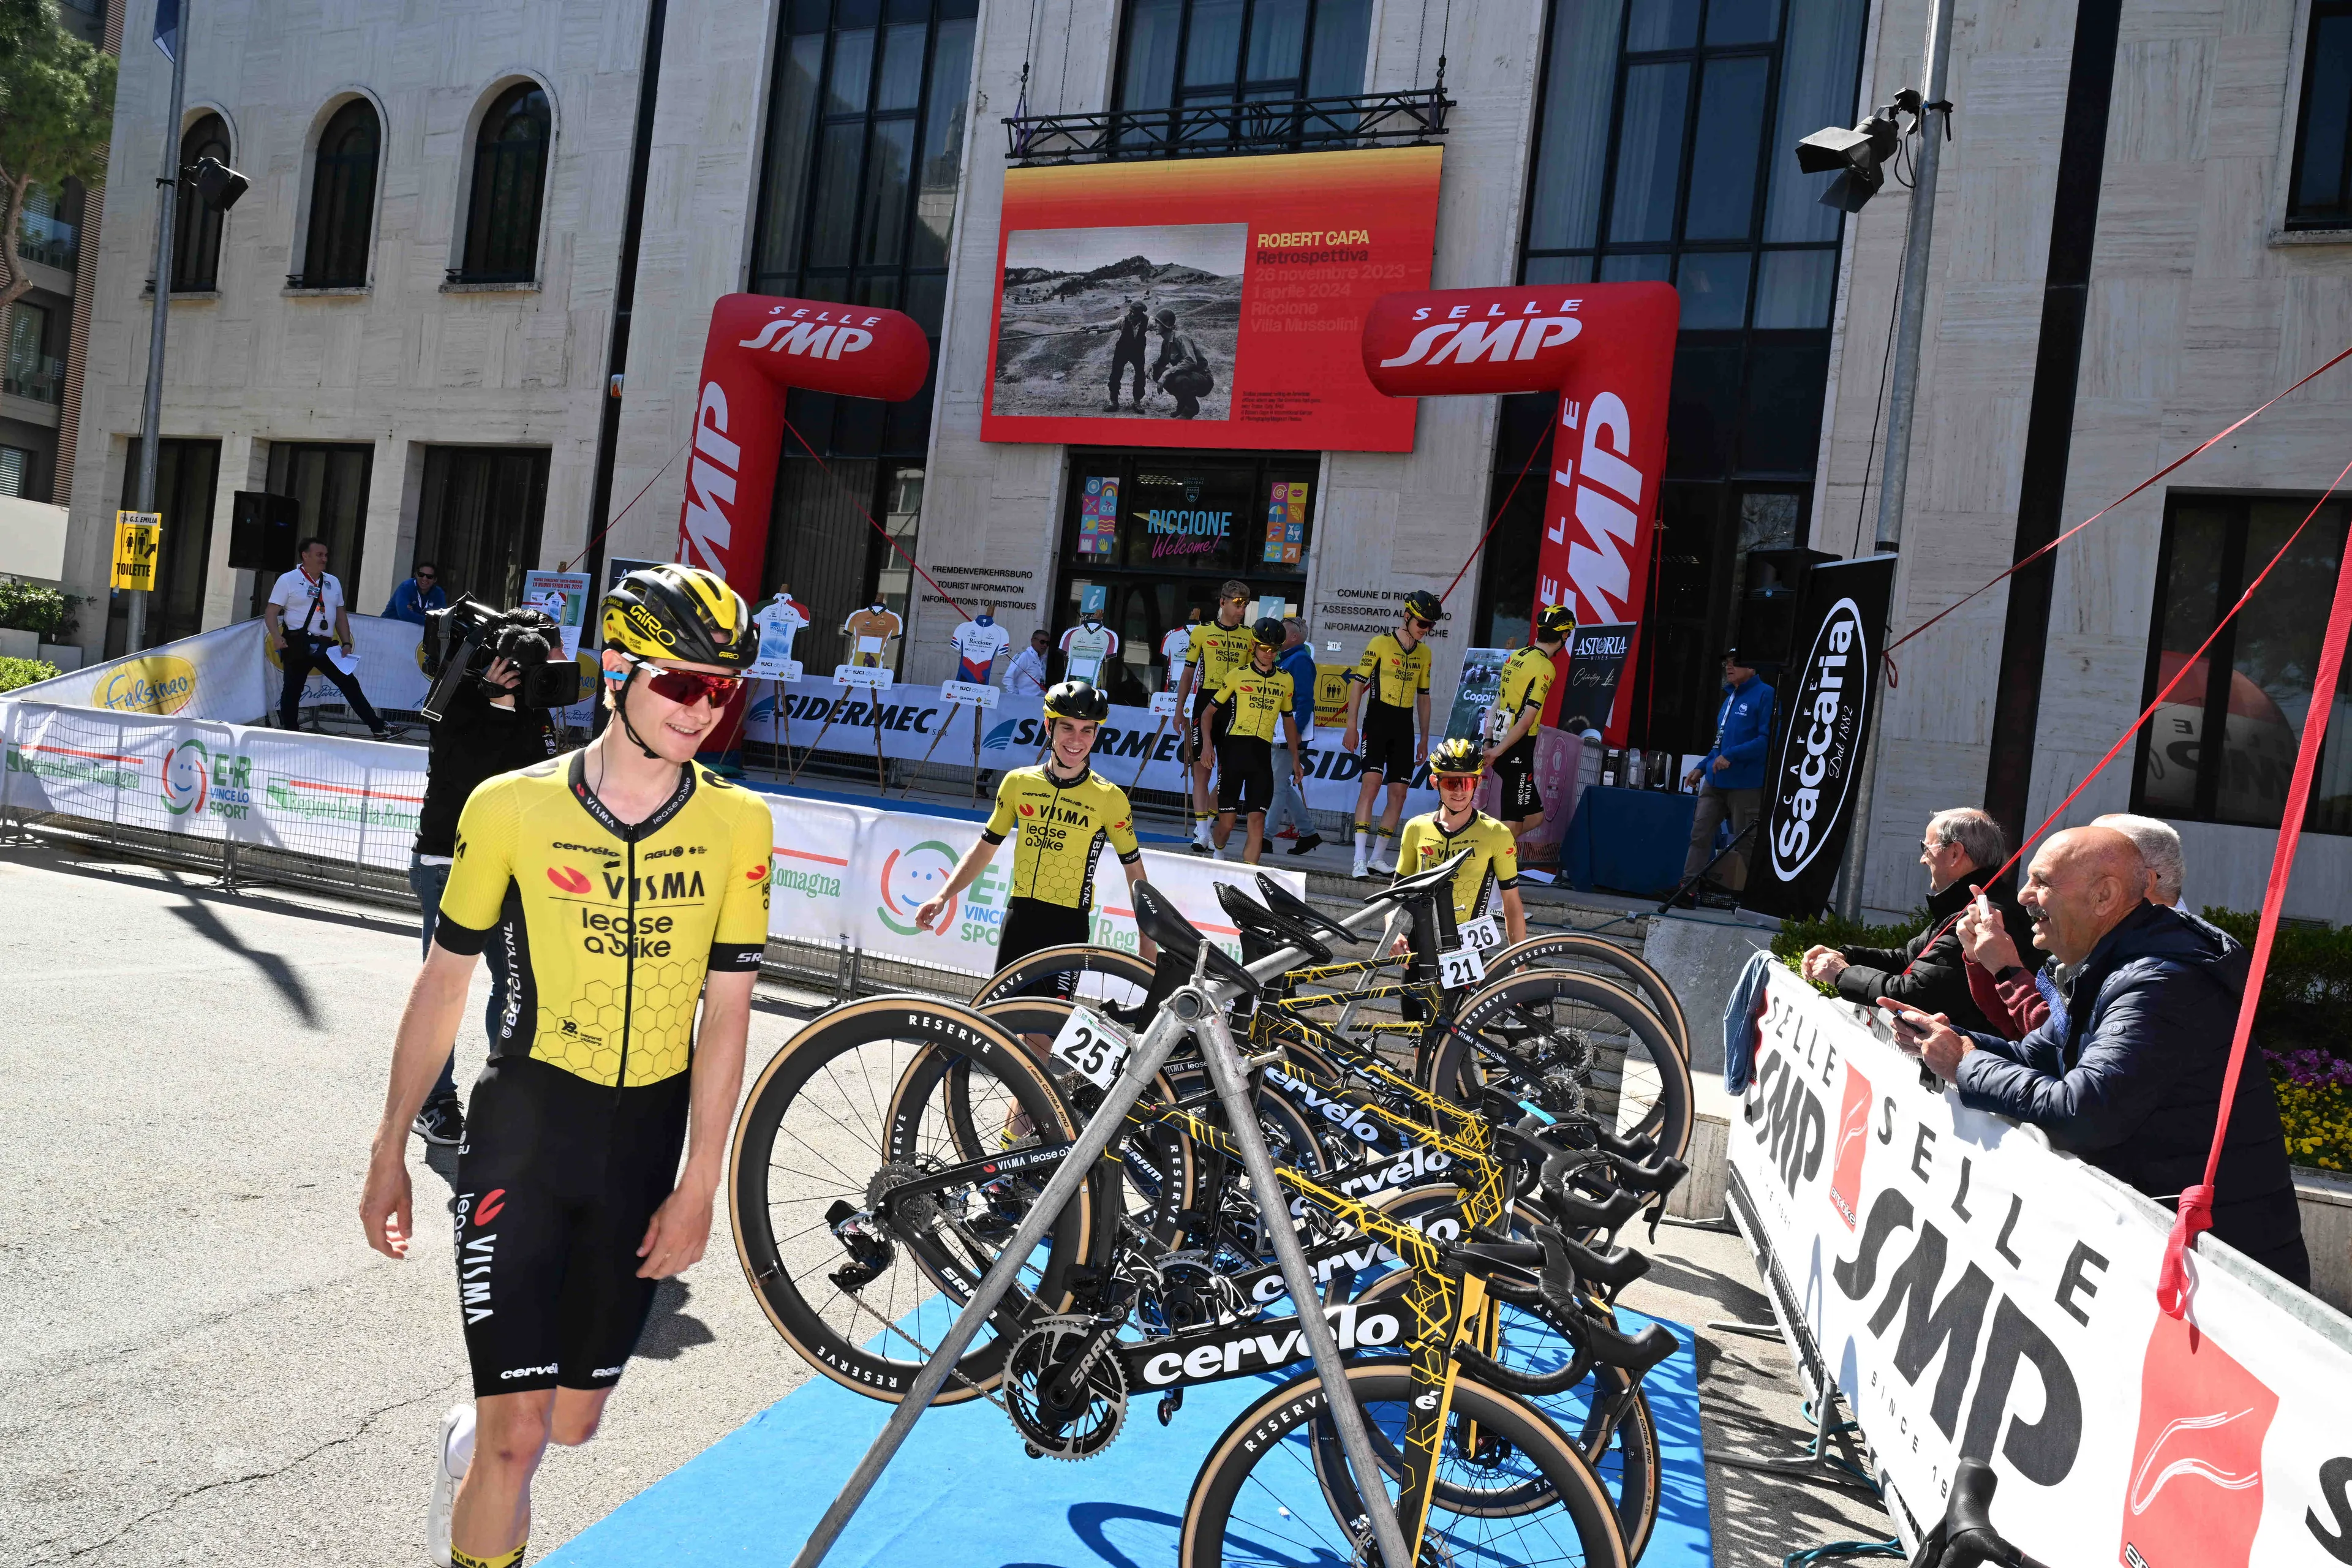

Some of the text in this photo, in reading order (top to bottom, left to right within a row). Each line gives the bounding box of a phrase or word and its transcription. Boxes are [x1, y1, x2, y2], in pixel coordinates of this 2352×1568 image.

[1257, 230, 1370, 247] ROBERT CAPA
[1256, 247, 1368, 265] Retrospettiva
[1255, 264, 1405, 281] 26 novembre 2023
[1262, 284, 1304, 301] aprile
[1309, 282, 1351, 297] 2024
[769, 306, 881, 327] SELLE
[1251, 301, 1318, 316] Riccione
[1412, 299, 1583, 320] SELLE
[1250, 317, 1358, 333] Villa Mussolini
[739, 320, 873, 361] SMP
[1379, 317, 1583, 368] SMP
[1148, 510, 1232, 537] RICCIONE
[1152, 529, 1223, 559] Welcome!
[116, 562, 151, 577] TOILETTE
[932, 565, 1033, 579] FREMDENVERKEHRSBURO
[937, 581, 1023, 594] TOURIST INFORMATION
[1337, 589, 1391, 600] COMUNE DI
[922, 595, 1036, 610] INFORMATIONS TOURISTIQUES
[1322, 605, 1390, 617] ASSESSORATO
[629, 605, 676, 646] GIRO
[1324, 622, 1390, 633] NFORMAZIONI
[969, 638, 992, 646] Riccione
[1221, 641, 1248, 650] VISMA
[1575, 636, 1627, 655] ASTORIA
[718, 650, 739, 660] GIRO
[1402, 660, 1420, 669] VISMA
[1396, 668, 1414, 677] lease
[1572, 668, 1600, 687] Celebrating
[104, 674, 188, 710] Felsineo
[1250, 695, 1275, 704] lease
[1257, 686, 1284, 697] VISMA
[1463, 689, 1491, 704] Coppi
[772, 694, 938, 734] SIDERMEC
[1778, 620, 1855, 862] Saccaria
[1829, 705, 1854, 778] Dal 1882
[213, 753, 252, 790] E-R
[210, 788, 249, 803] VINCE LO
[209, 801, 249, 820] SPORT
[586, 796, 615, 827] VISMA
[653, 801, 679, 824] lease
[1040, 805, 1088, 827] VISMA
[1027, 823, 1066, 839] lease
[552, 842, 620, 858] cervélo
[644, 848, 673, 861] AGU
[1082, 840, 1101, 908] BETCITY.NL
[602, 871, 705, 902] VISMA
[582, 907, 673, 935] lease
[1468, 925, 1494, 951] 26
[1510, 945, 1562, 966] RESERVE
[503, 922, 522, 1027] BETCITY.NL
[1449, 958, 1477, 986] 21
[580, 1032, 601, 1041] beyond
[909, 1015, 992, 1055] RESERVE
[1458, 1030, 1491, 1054] VISMA lease
[1765, 996, 1837, 1088] SELLE
[1062, 1027, 1112, 1075] 25
[1187, 1061, 1208, 1070] lease
[1030, 1068, 1070, 1128] vittoria CORSA PRO
[1265, 1066, 1378, 1141] ervélo
[1744, 1049, 1826, 1201] SMP
[997, 1156, 1027, 1171] VISMA
[1030, 1151, 1058, 1164] lease
[1126, 1147, 1163, 1182] SRAM
[1167, 1144, 1182, 1224] RESERVE
[1875, 1096, 2110, 1328] SELLE
[462, 1234, 497, 1325] VISMA
[1832, 1187, 2082, 1487] SMP
[817, 1346, 898, 1389] RESERVE
[1071, 1327, 1118, 1389] SRAM
[1870, 1370, 1920, 1455] SINCE
[1639, 1418, 1651, 1447] CORSA
